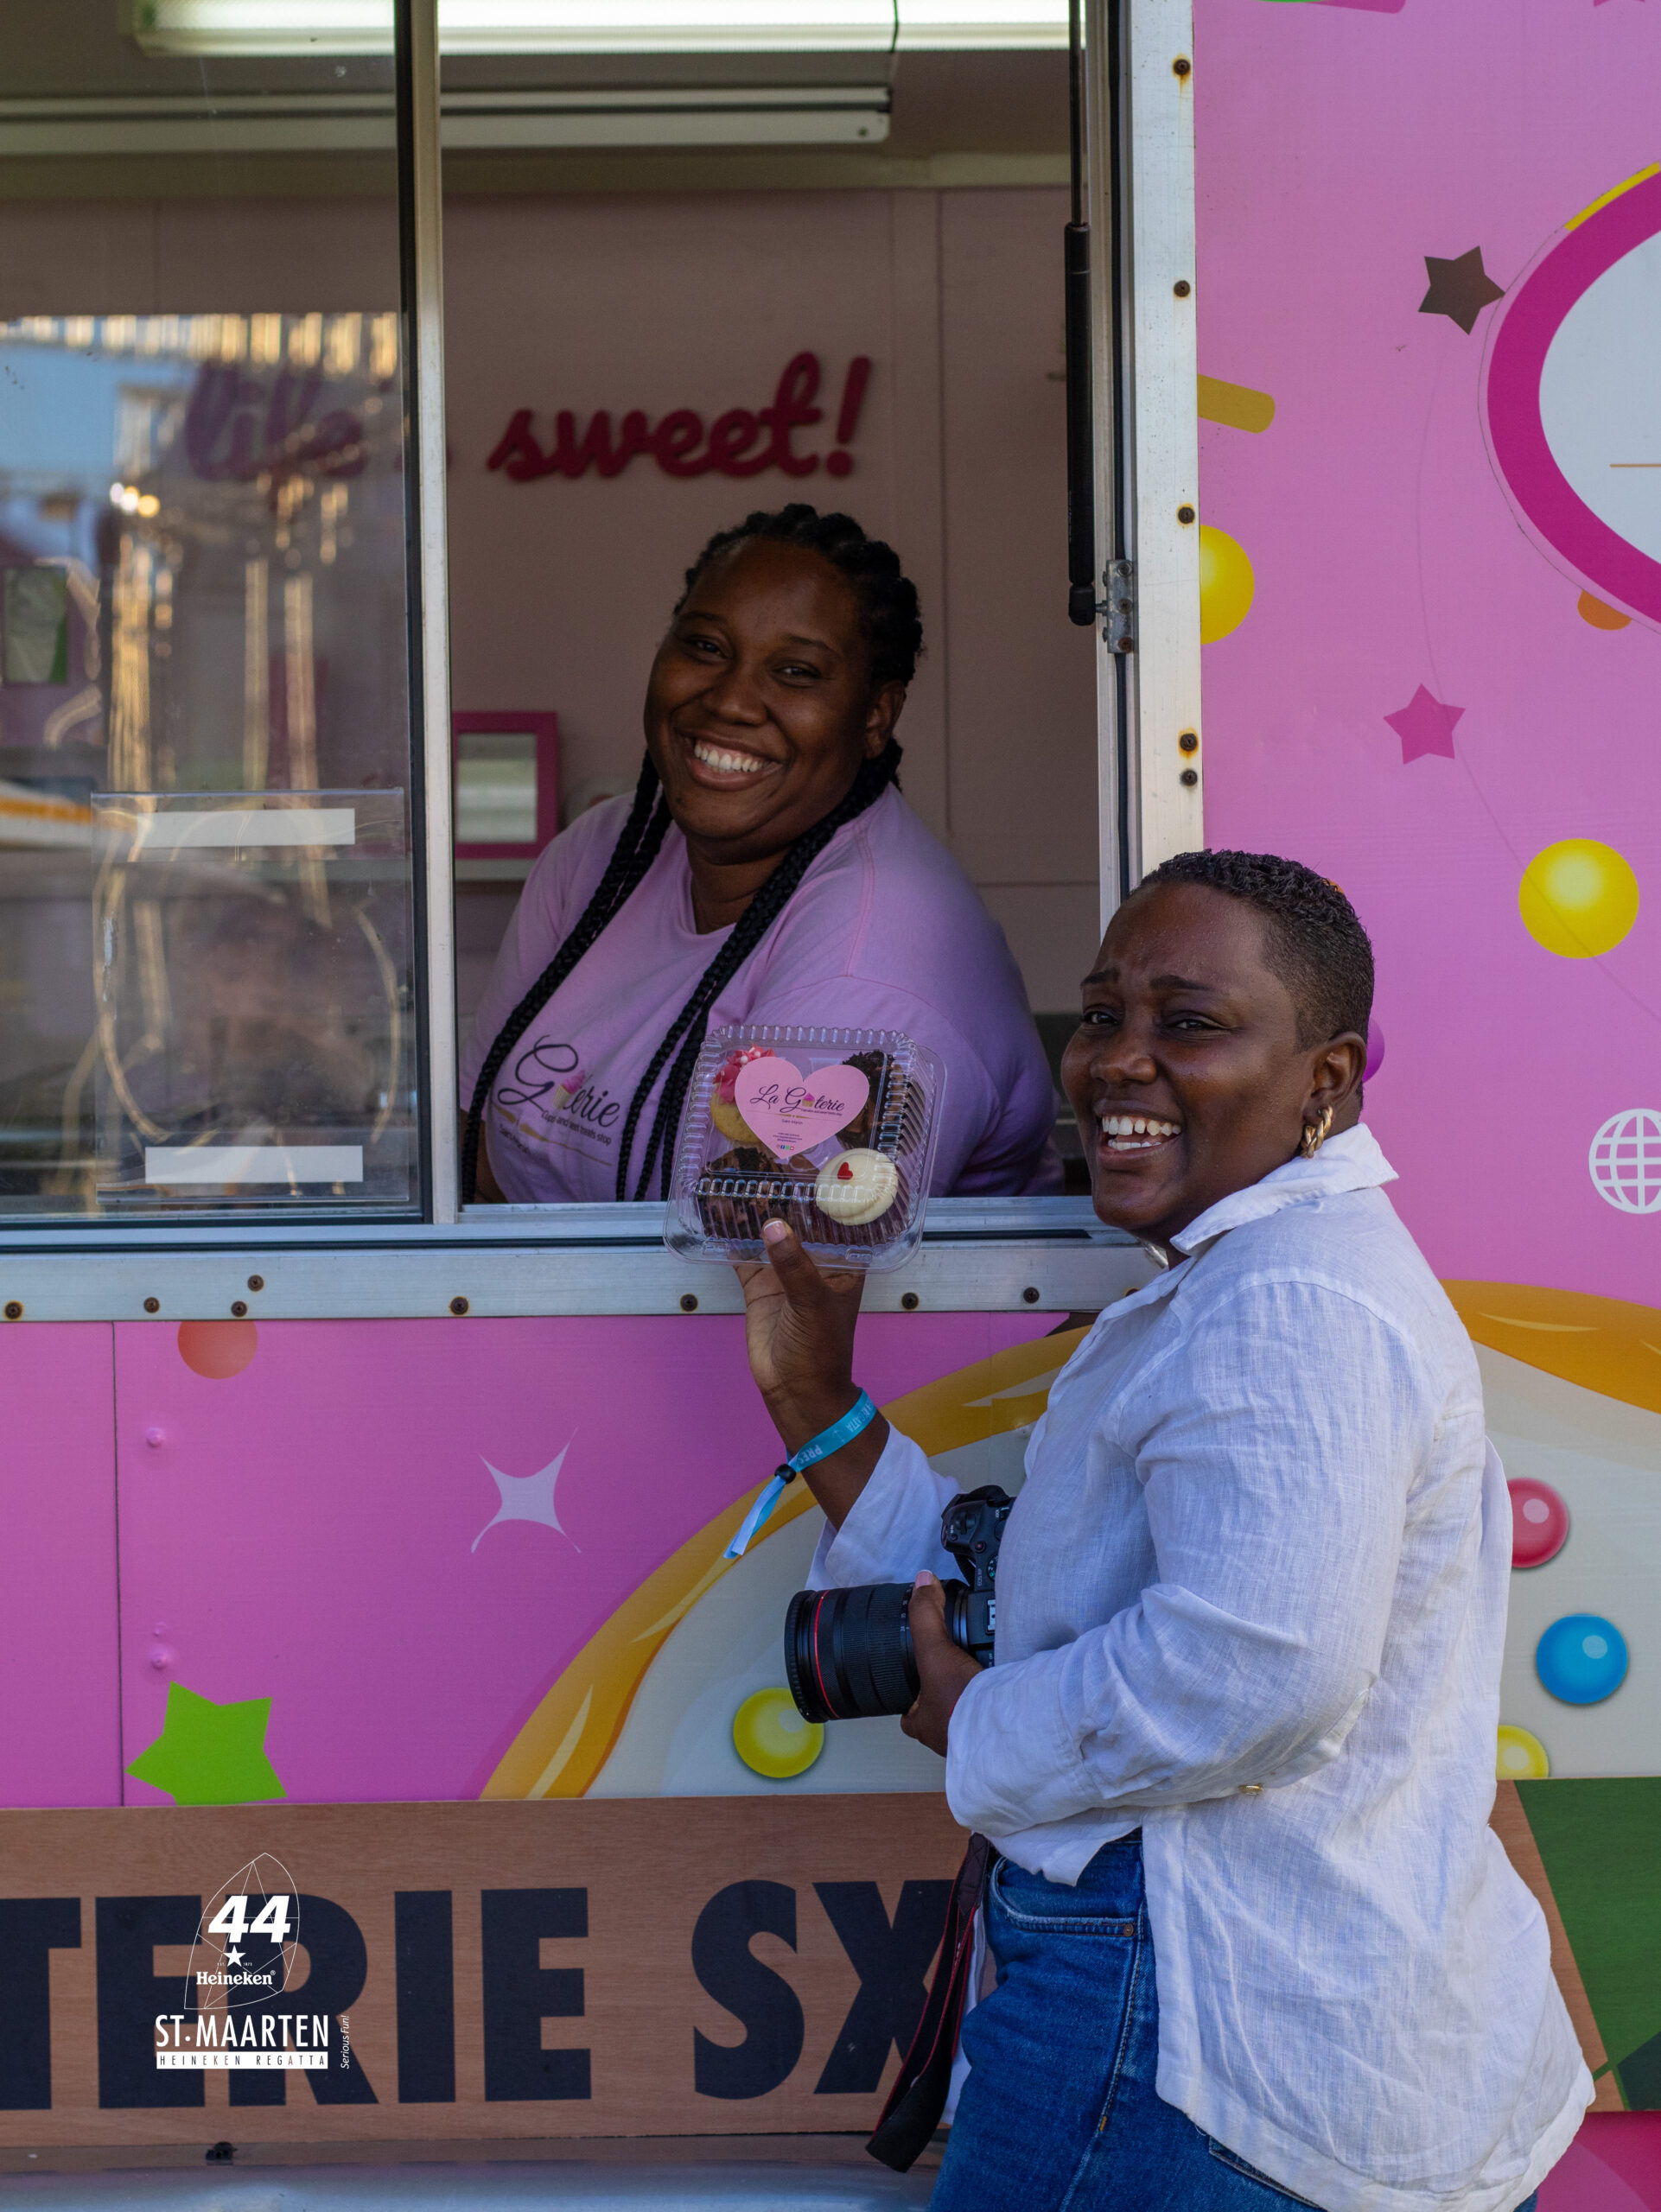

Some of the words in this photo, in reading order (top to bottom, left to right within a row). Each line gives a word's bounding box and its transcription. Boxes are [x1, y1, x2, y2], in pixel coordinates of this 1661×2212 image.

[487, 352, 871, 482] sweet!
[749, 1084, 780, 1109] La
[596, 1133, 613, 1147] stop
